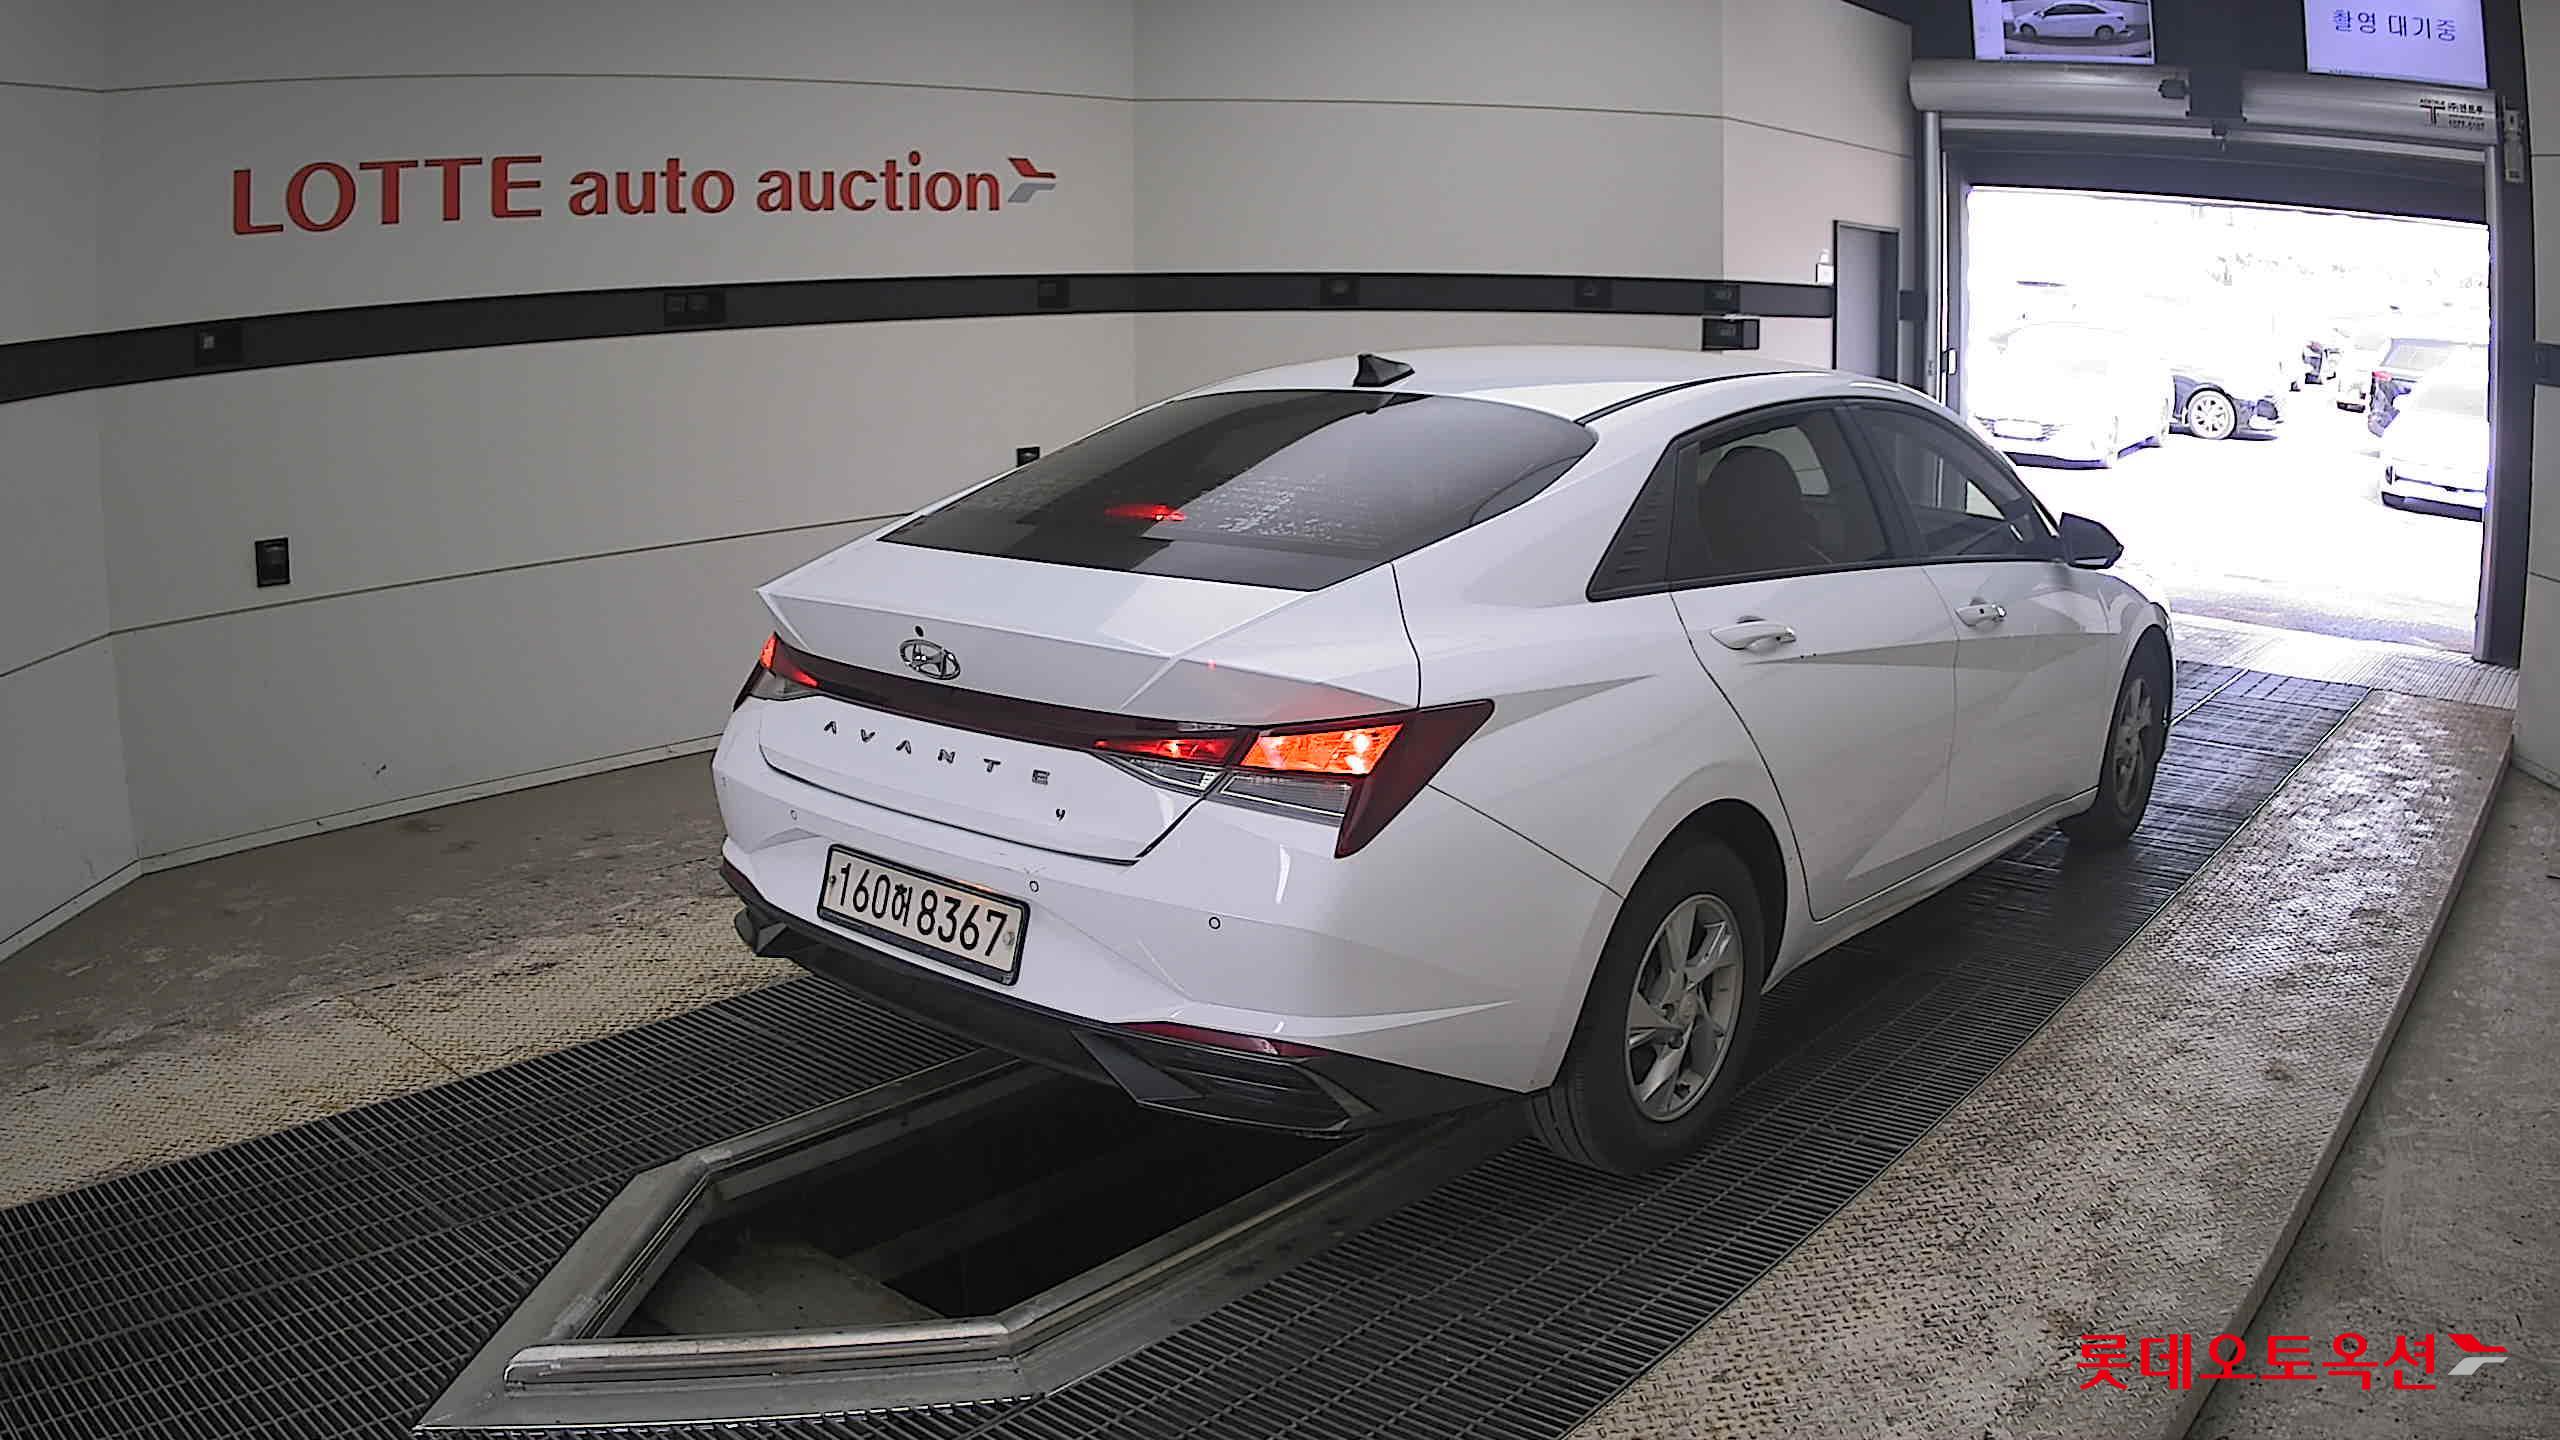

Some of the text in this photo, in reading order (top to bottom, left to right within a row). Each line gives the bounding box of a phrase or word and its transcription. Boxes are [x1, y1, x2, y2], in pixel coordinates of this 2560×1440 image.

[2388, 14, 2456, 42] 대기중
[233, 150, 1000, 235] LOTTE auto auction
[823, 720, 1051, 786] AVANTE
